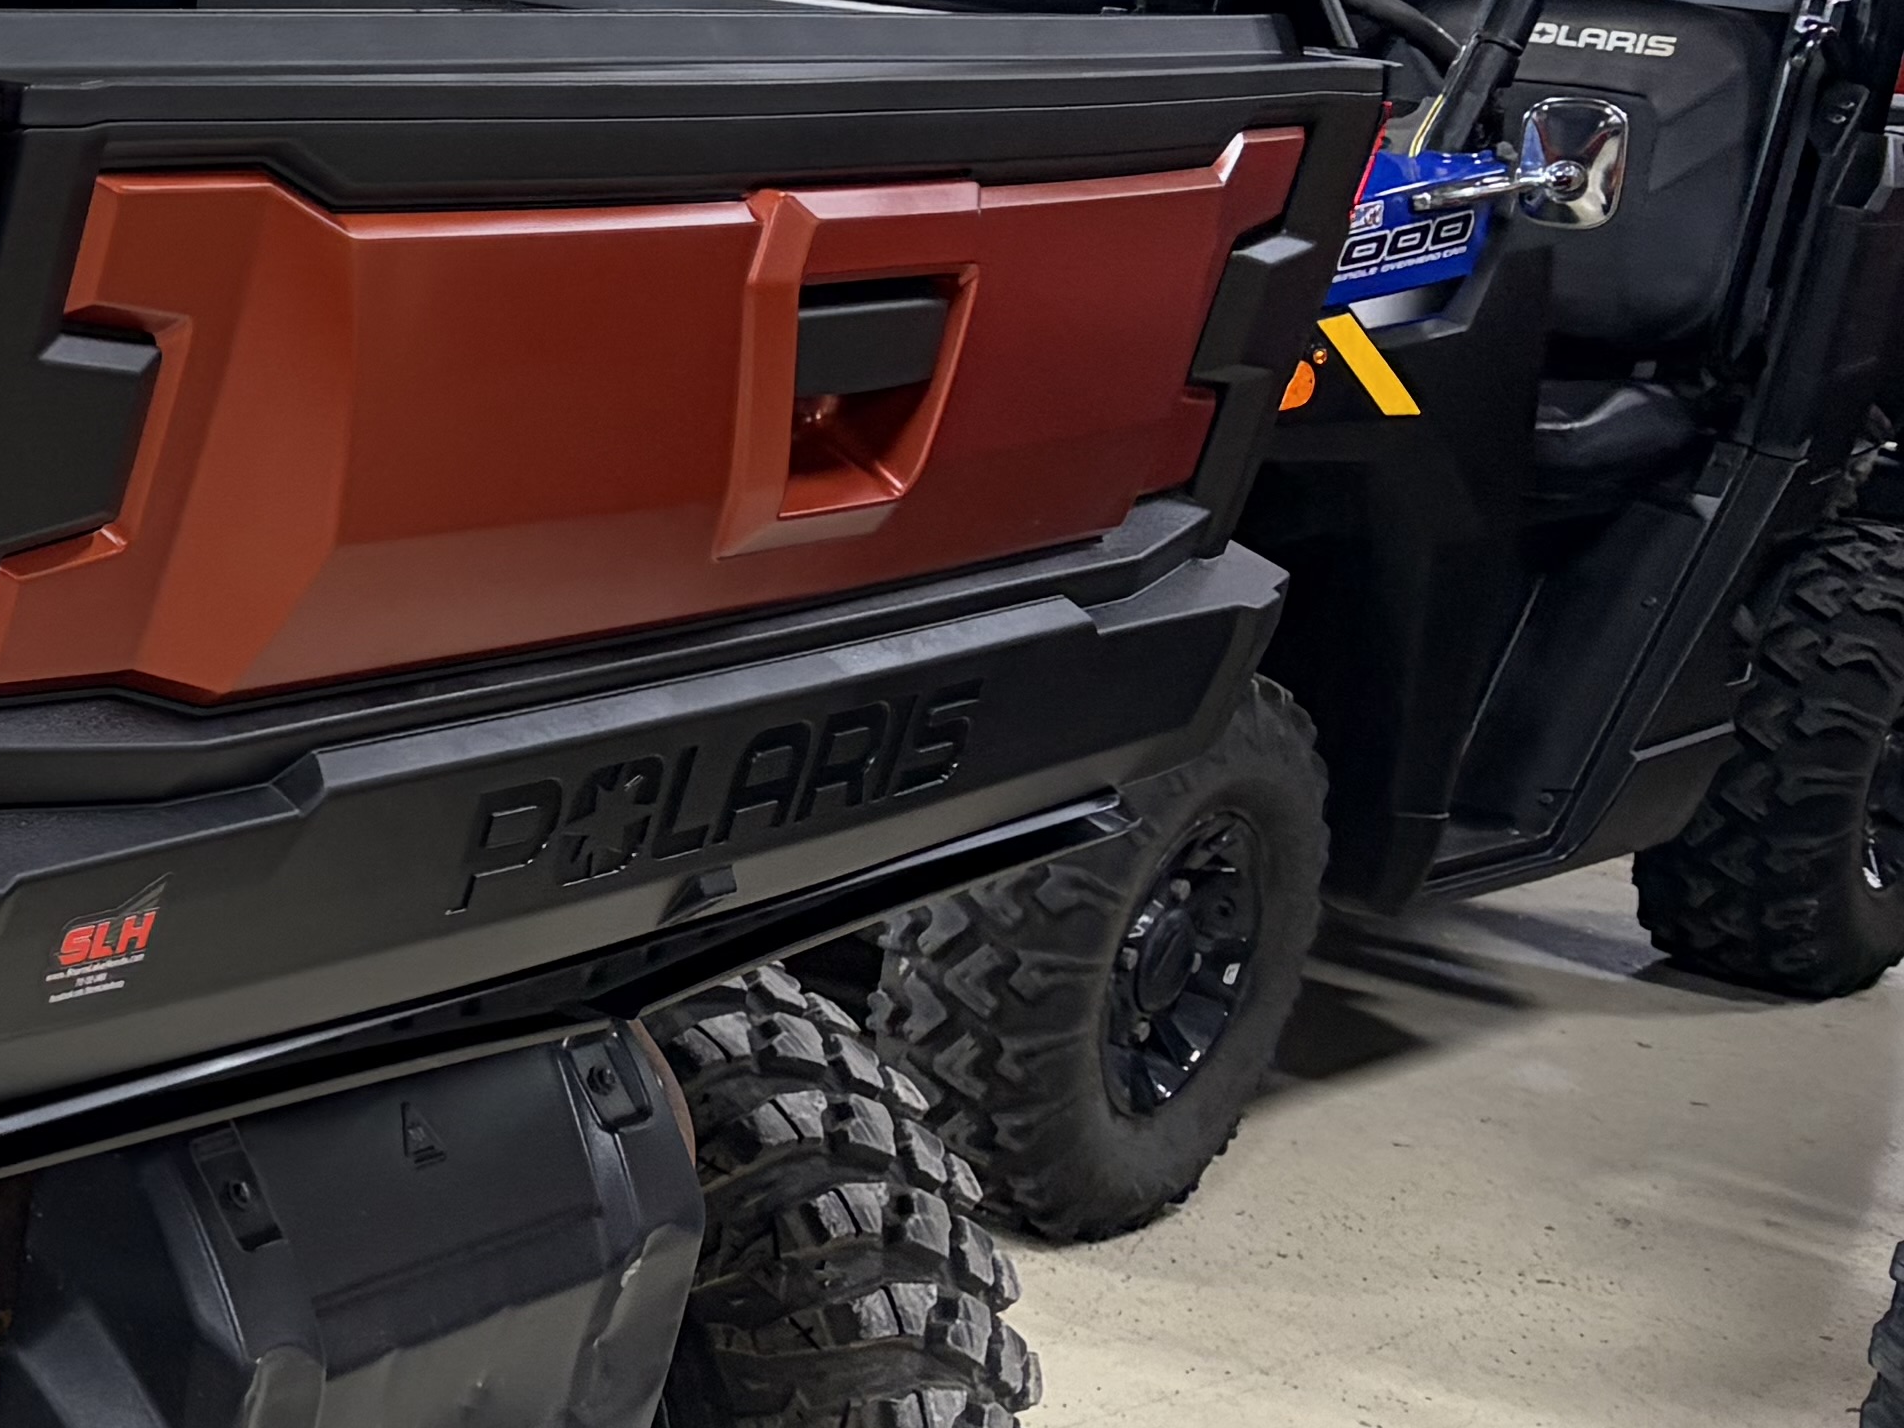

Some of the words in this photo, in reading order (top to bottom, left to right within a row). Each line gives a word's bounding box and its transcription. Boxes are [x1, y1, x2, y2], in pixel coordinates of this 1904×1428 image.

[1529, 21, 1677, 58] OLARIS
[1337, 210, 1475, 271] 000
[445, 679, 987, 916] POLARIS
[58, 910, 157, 967] SLH
